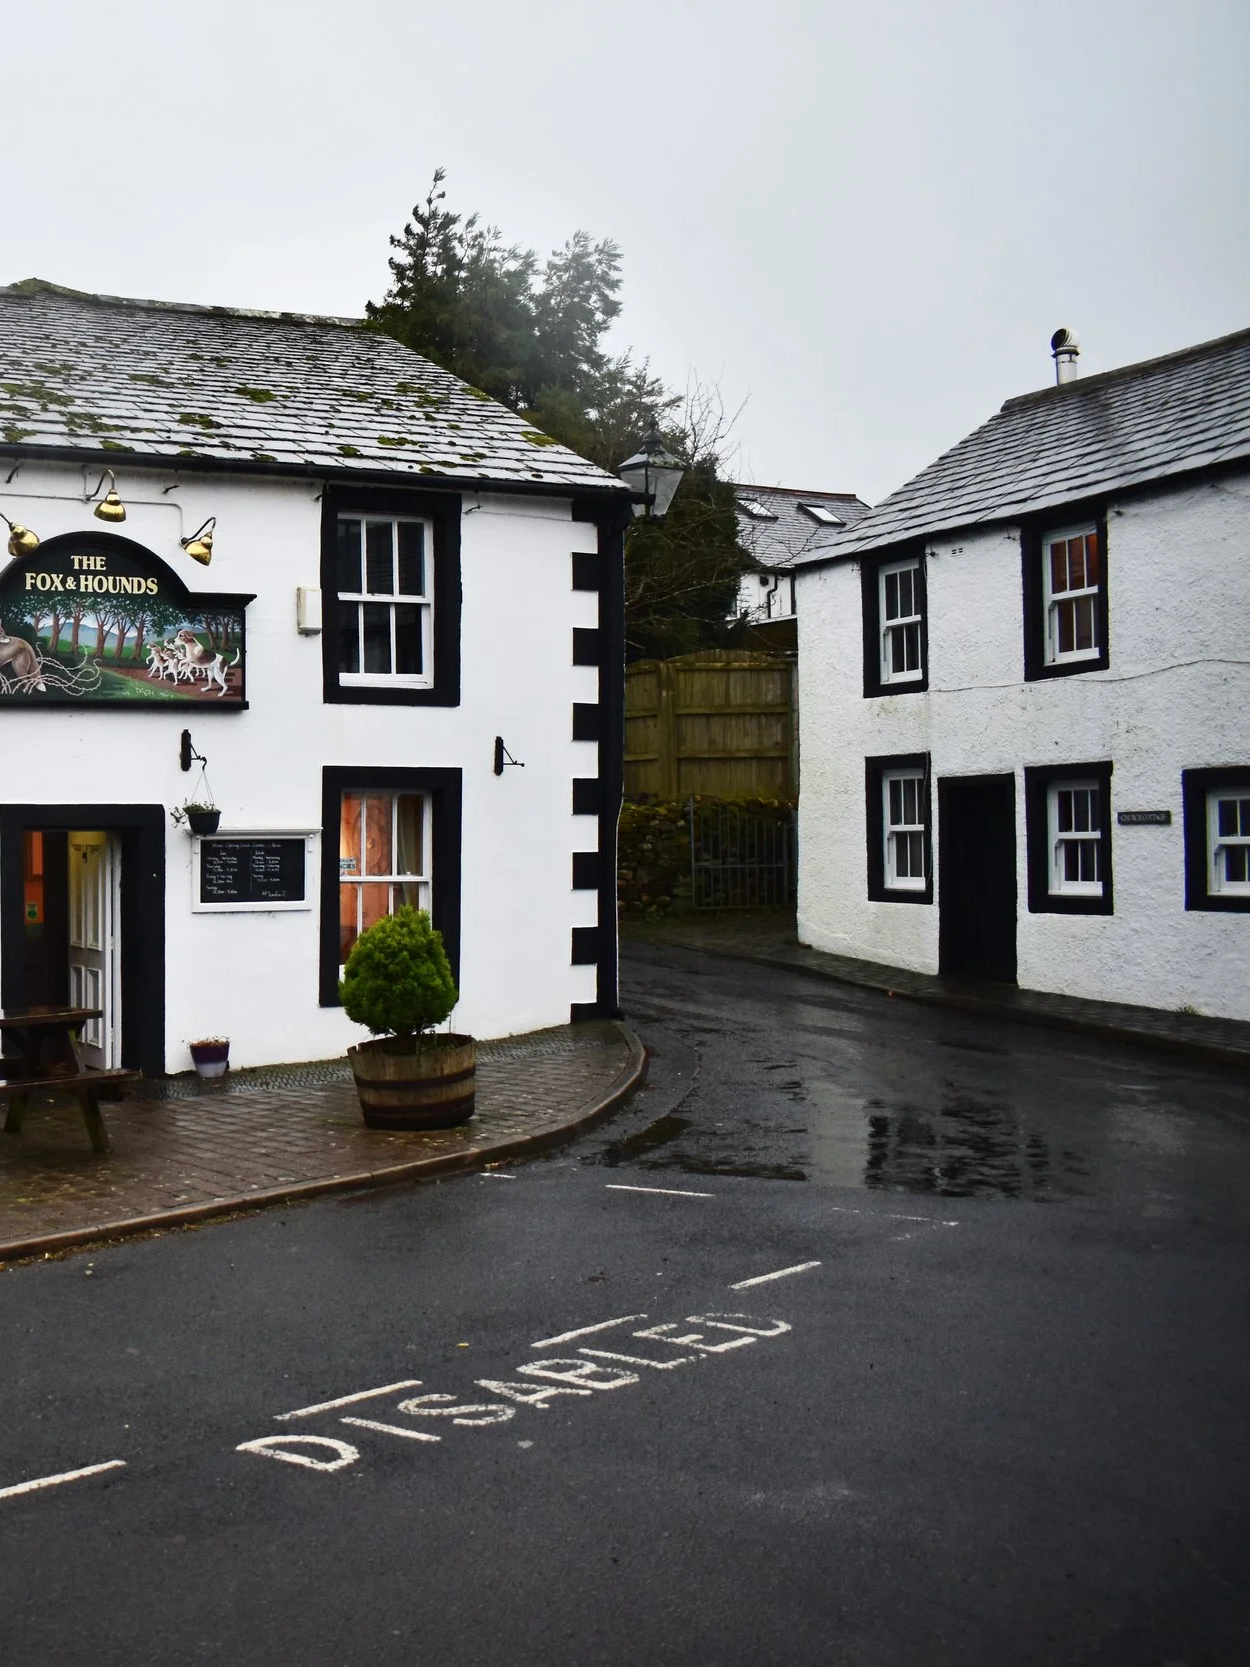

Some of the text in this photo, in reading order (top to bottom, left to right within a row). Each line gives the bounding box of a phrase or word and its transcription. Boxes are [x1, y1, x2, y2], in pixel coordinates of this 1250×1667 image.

[70, 555, 107, 571] THE
[25, 572, 159, 595] FOX & HOUNDS
[235, 1312, 793, 1473] DISABLED
